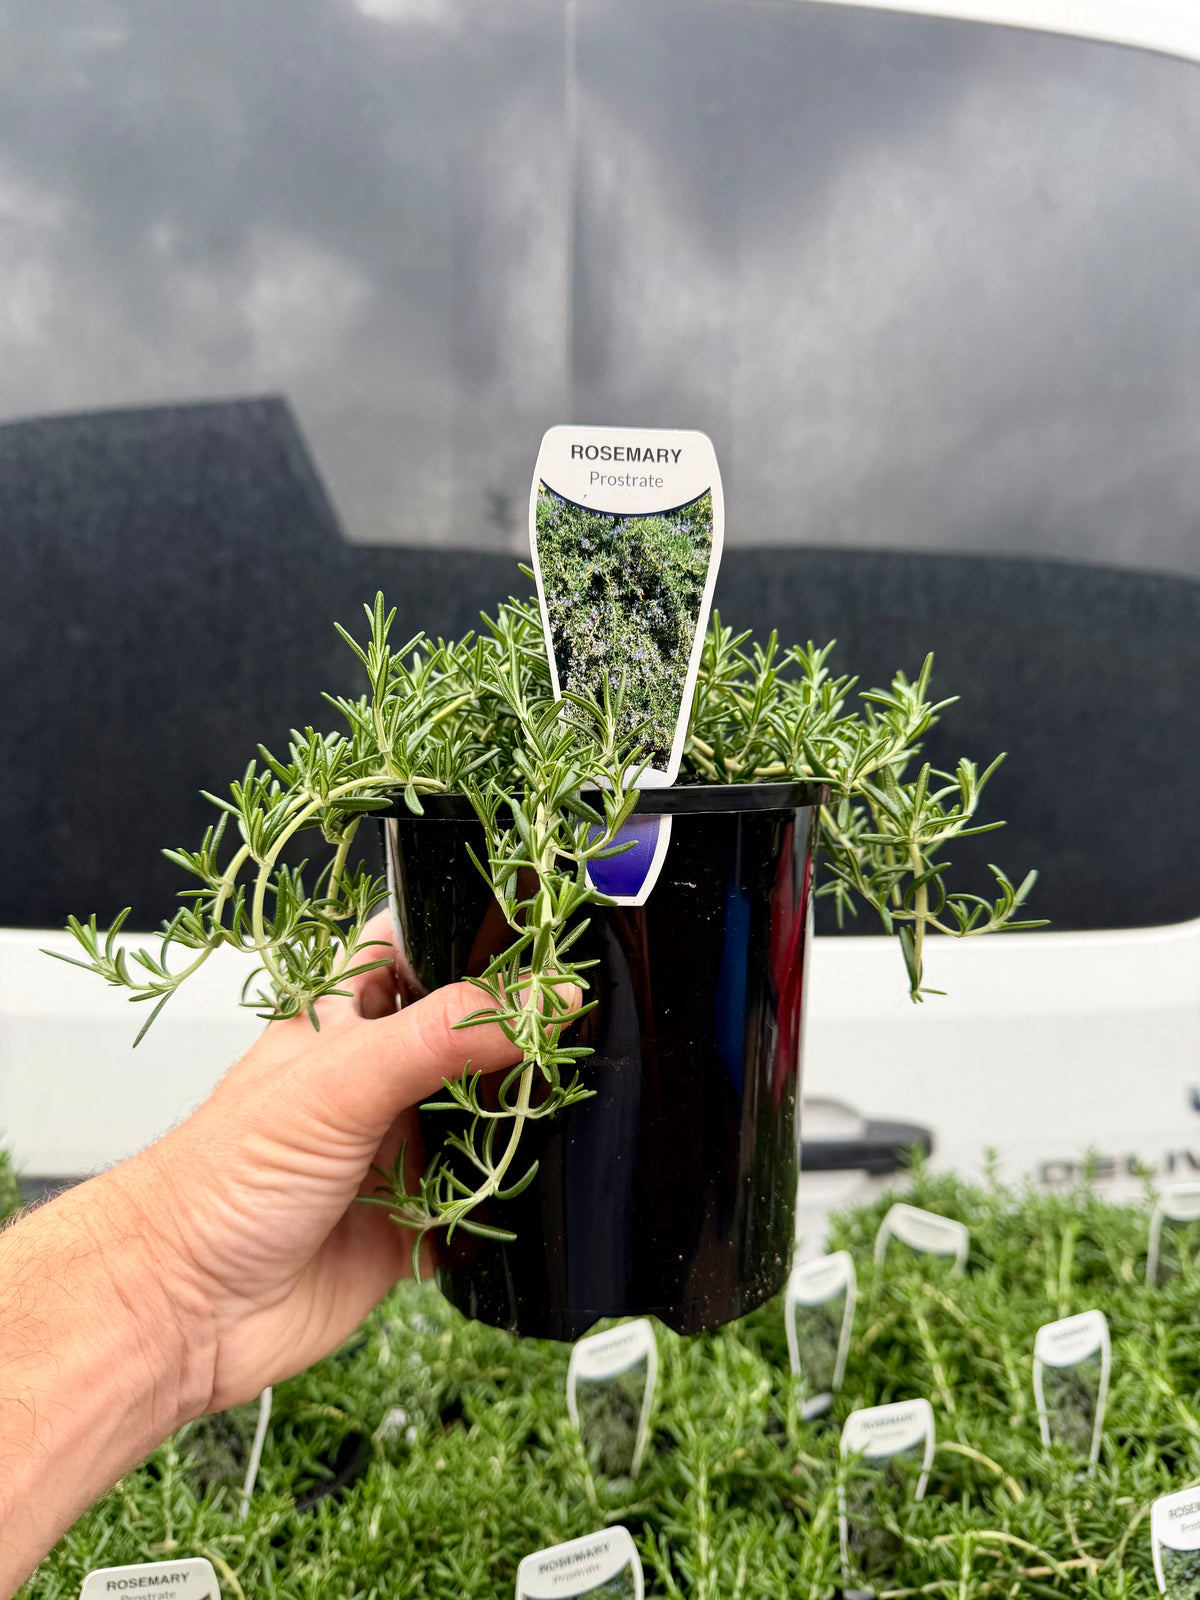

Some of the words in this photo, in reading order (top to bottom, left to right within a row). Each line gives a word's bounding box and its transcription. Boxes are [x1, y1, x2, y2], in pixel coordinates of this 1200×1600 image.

[571, 444, 682, 463] ROSEMARY
[589, 471, 664, 488] Prostrate
[106, 1571, 190, 1591] ROSEMARY
